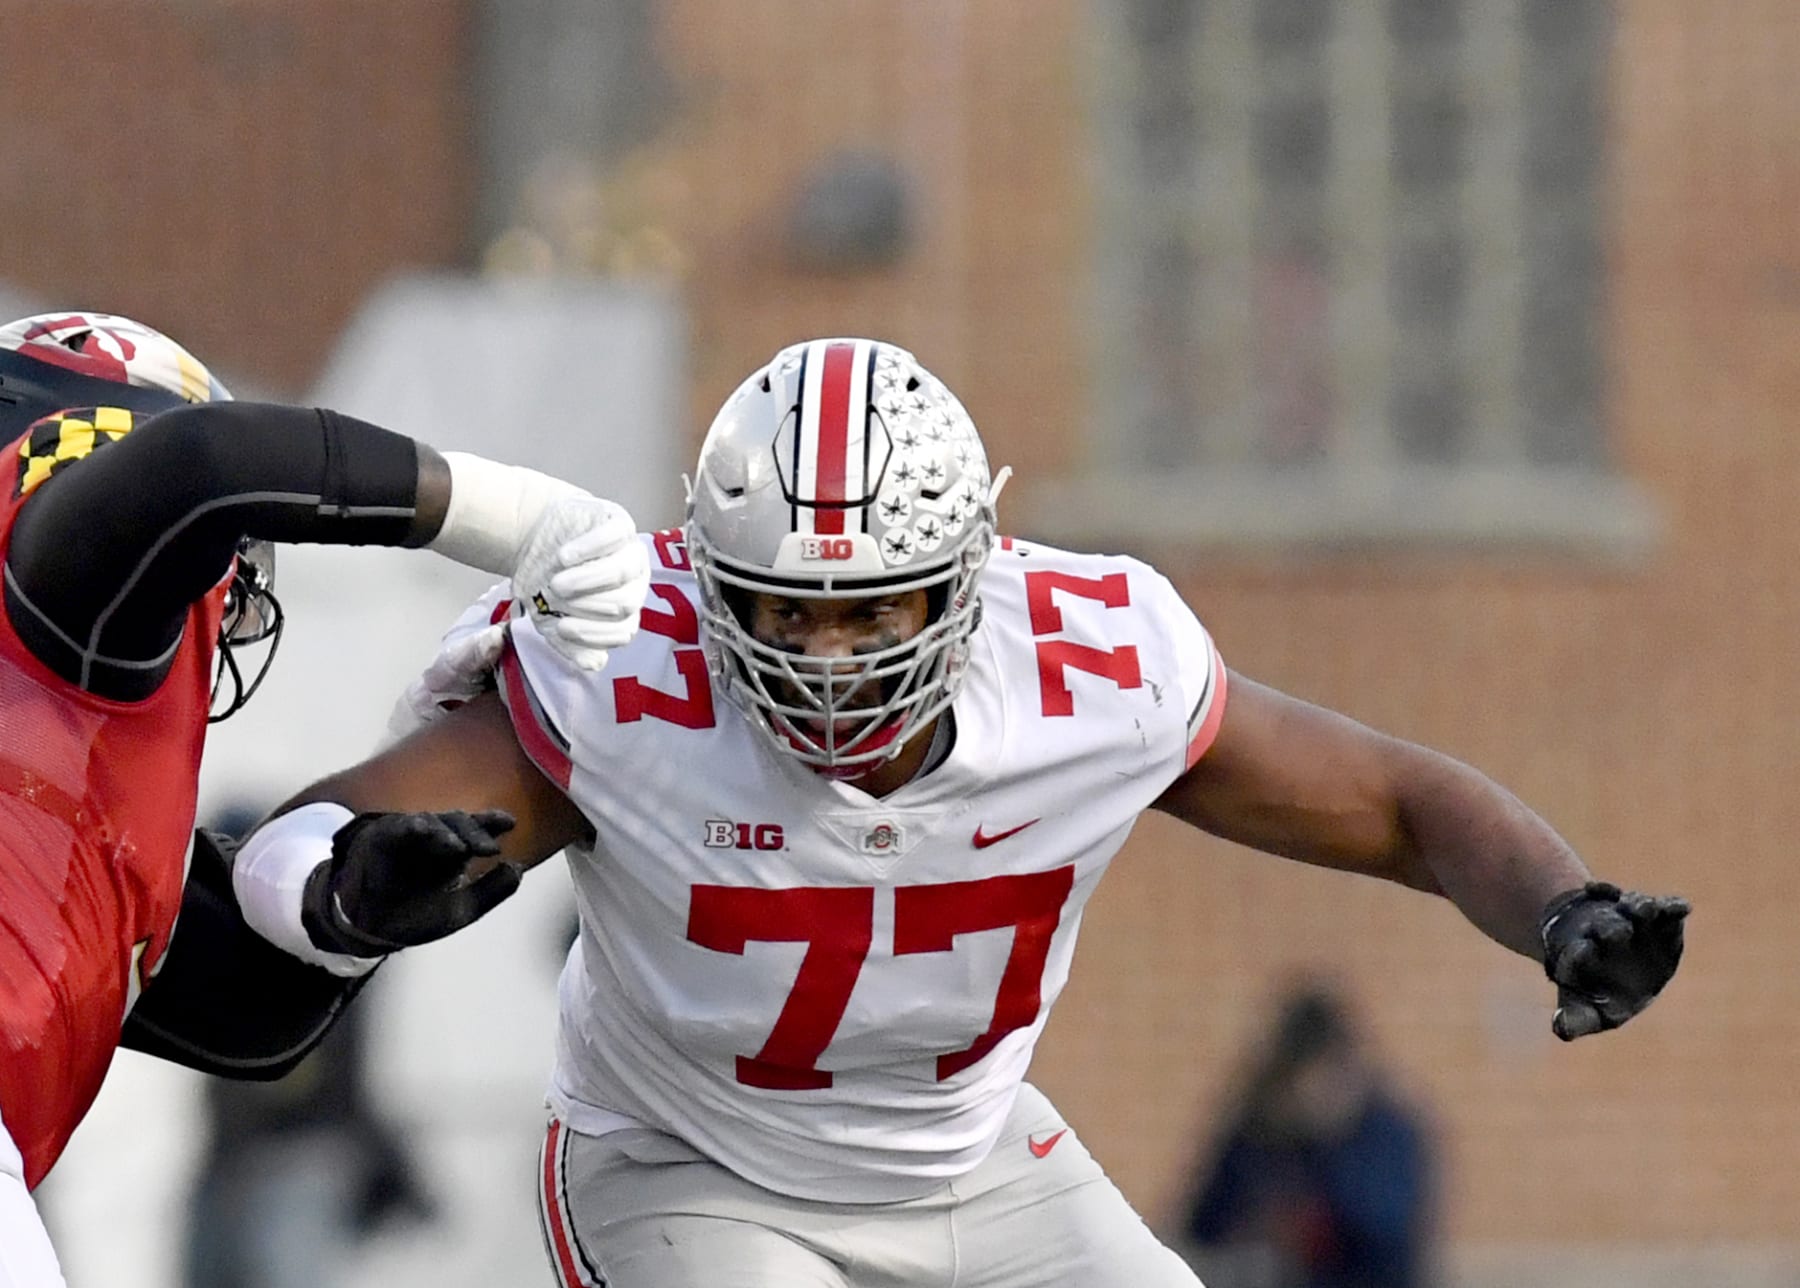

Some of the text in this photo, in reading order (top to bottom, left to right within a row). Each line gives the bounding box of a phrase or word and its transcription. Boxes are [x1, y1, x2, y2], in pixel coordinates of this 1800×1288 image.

[613, 583, 716, 729] 77
[1024, 570, 1142, 717] 77
[686, 864, 1075, 1090] 77
